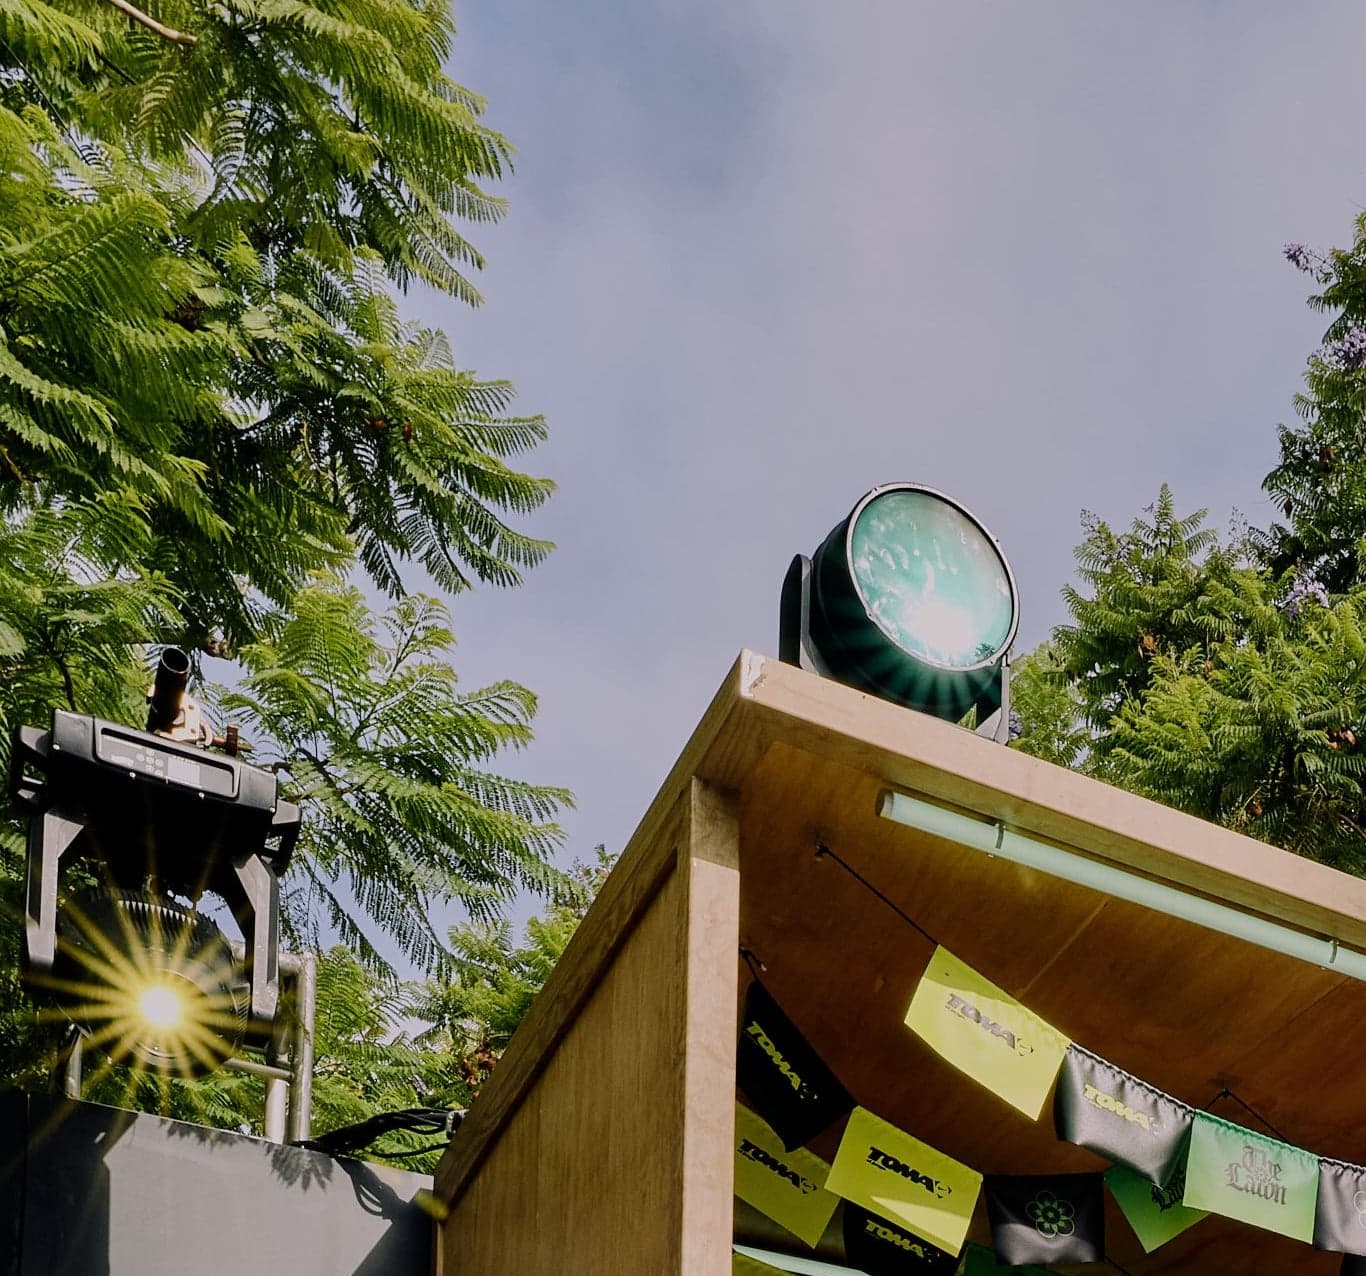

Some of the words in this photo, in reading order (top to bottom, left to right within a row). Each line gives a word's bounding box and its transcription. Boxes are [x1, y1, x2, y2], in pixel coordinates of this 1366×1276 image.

[947, 993, 1016, 1050] TOMA
[746, 1020, 802, 1091] TOMA
[1084, 1084, 1151, 1130] TOMA
[739, 1138, 802, 1191] TOMA
[868, 1145, 938, 1192] TOMA
[1243, 1145, 1282, 1182] The
[864, 1219, 926, 1259] TOMA
